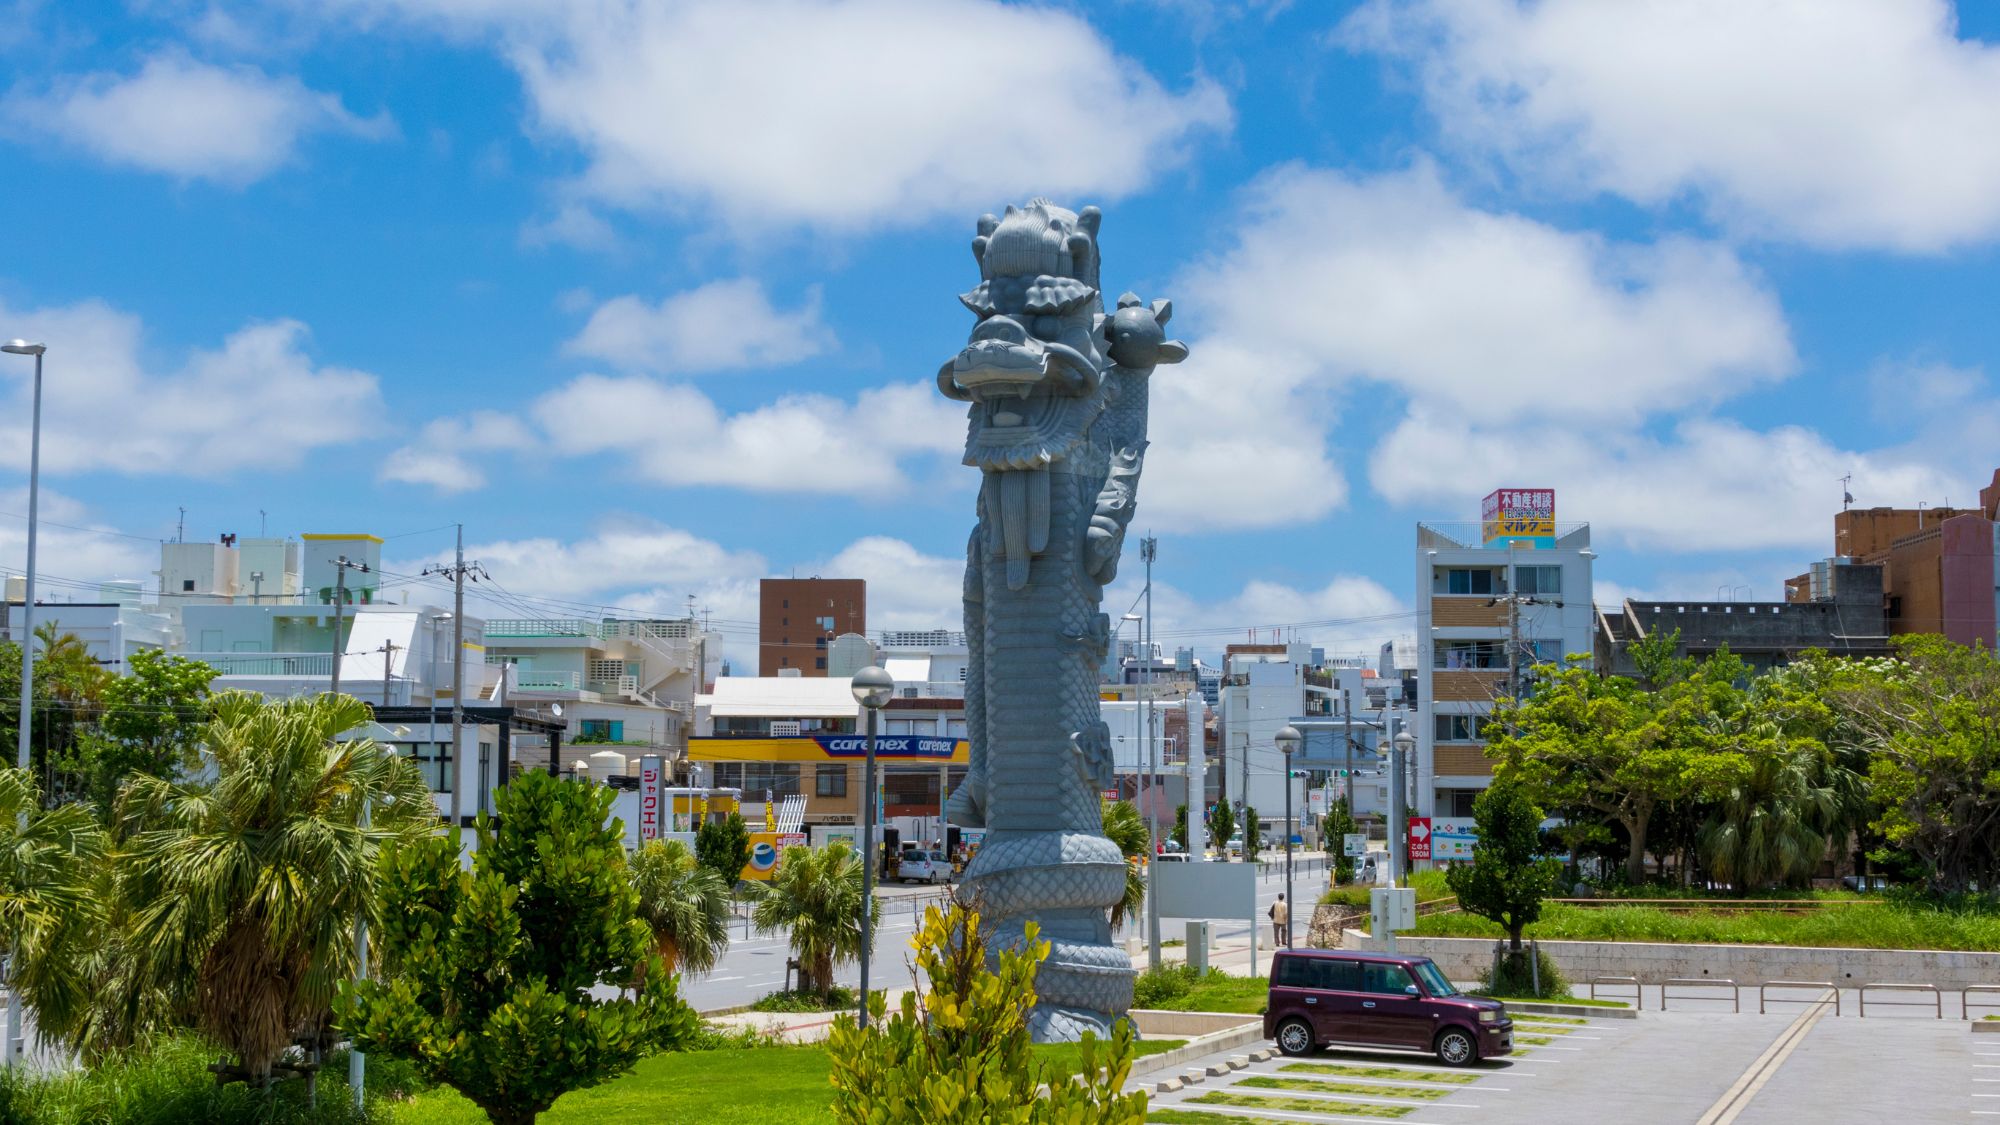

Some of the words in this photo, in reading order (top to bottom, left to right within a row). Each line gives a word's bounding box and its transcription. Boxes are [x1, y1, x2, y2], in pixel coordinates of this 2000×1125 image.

[1502, 492, 1552, 508] 不動産相談
[829, 739, 909, 751] carenex
[918, 739, 952, 752] carenex
[643, 768, 658, 840] ジャクエツ
